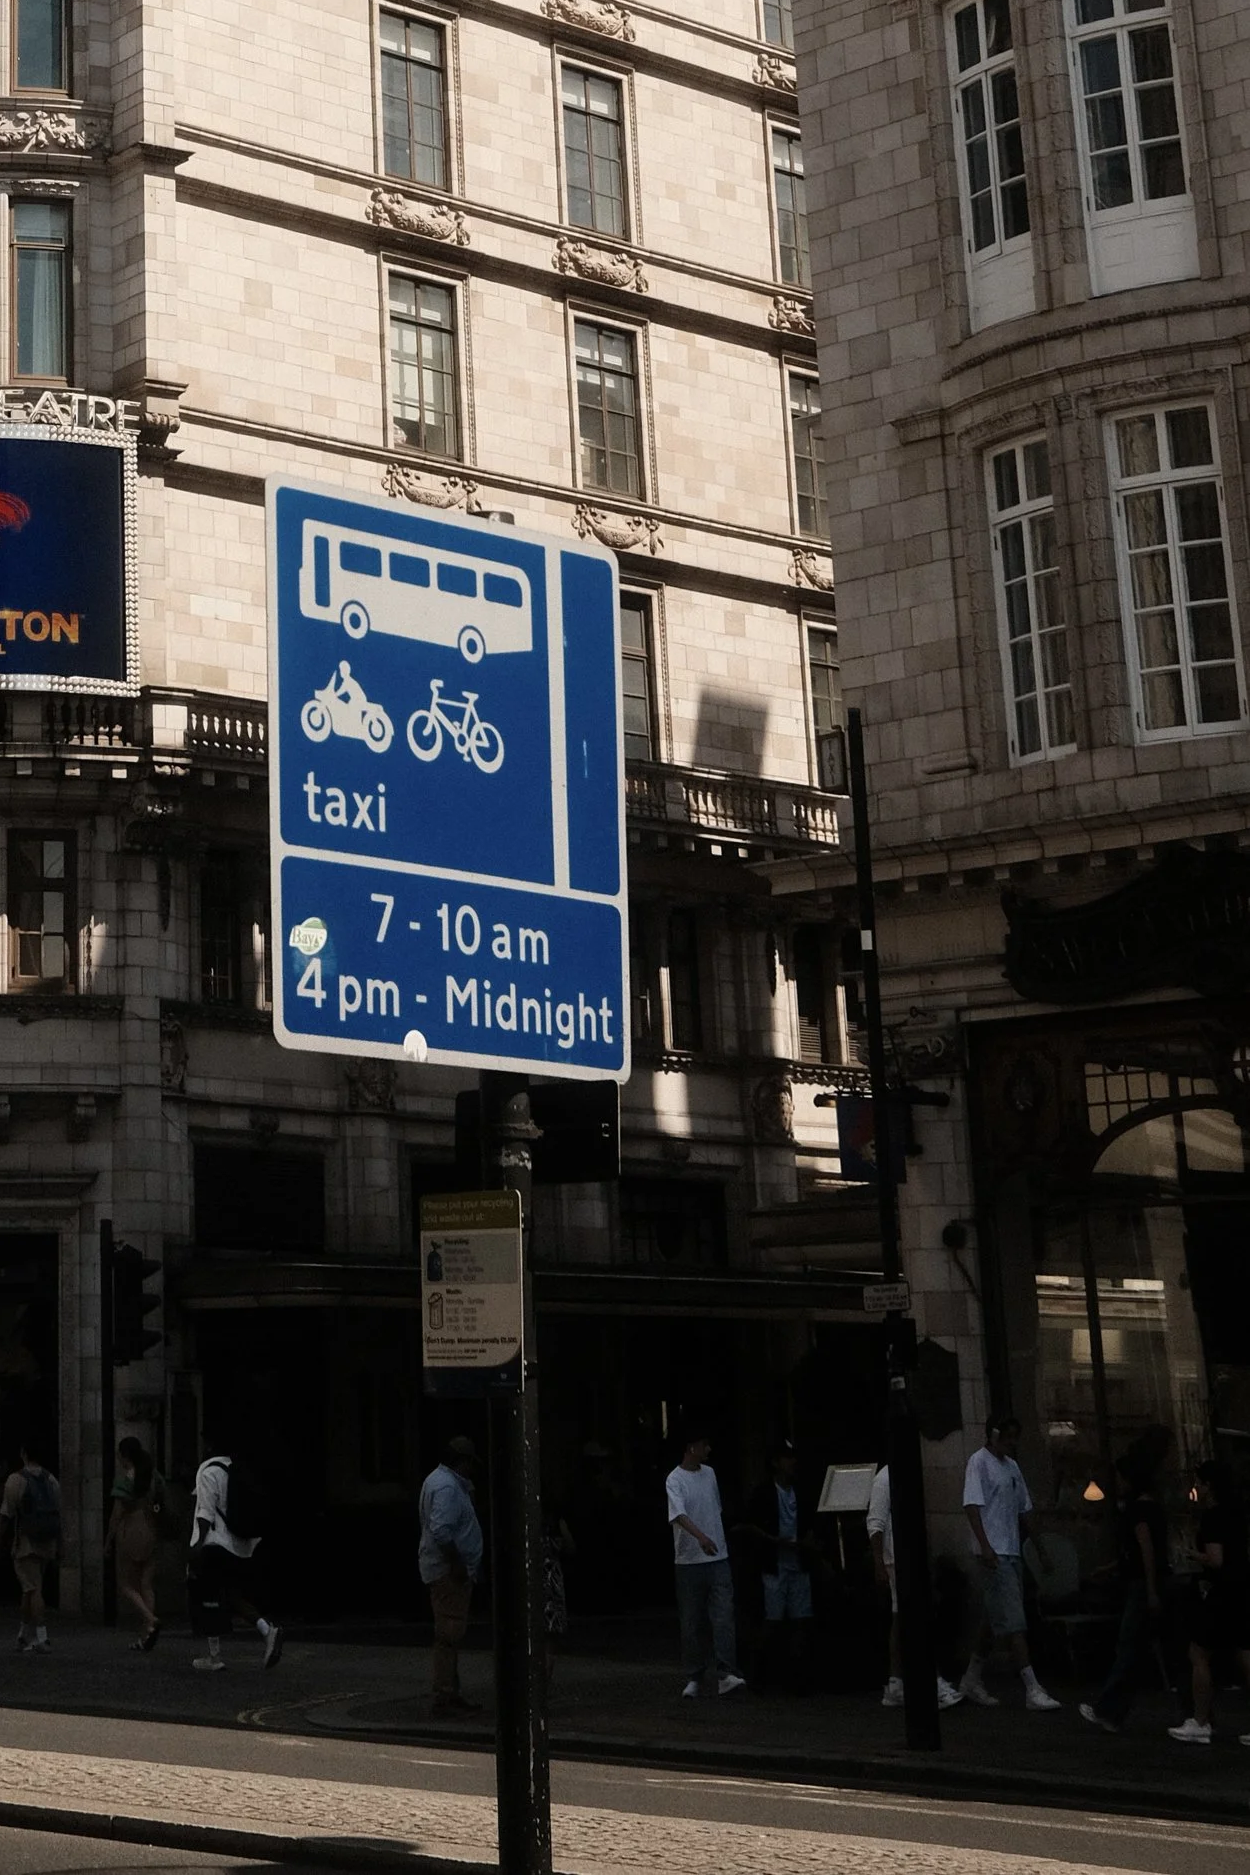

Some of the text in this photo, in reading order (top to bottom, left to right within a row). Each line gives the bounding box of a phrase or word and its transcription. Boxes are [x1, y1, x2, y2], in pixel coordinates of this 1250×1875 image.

[304, 772, 387, 833] taxi
[371, 894, 395, 943] 7
[436, 904, 481, 955] 10
[491, 923, 549, 965] am
[296, 957, 328, 1008] 4
[338, 976, 400, 1023] pm
[445, 976, 613, 1049] Midnight
